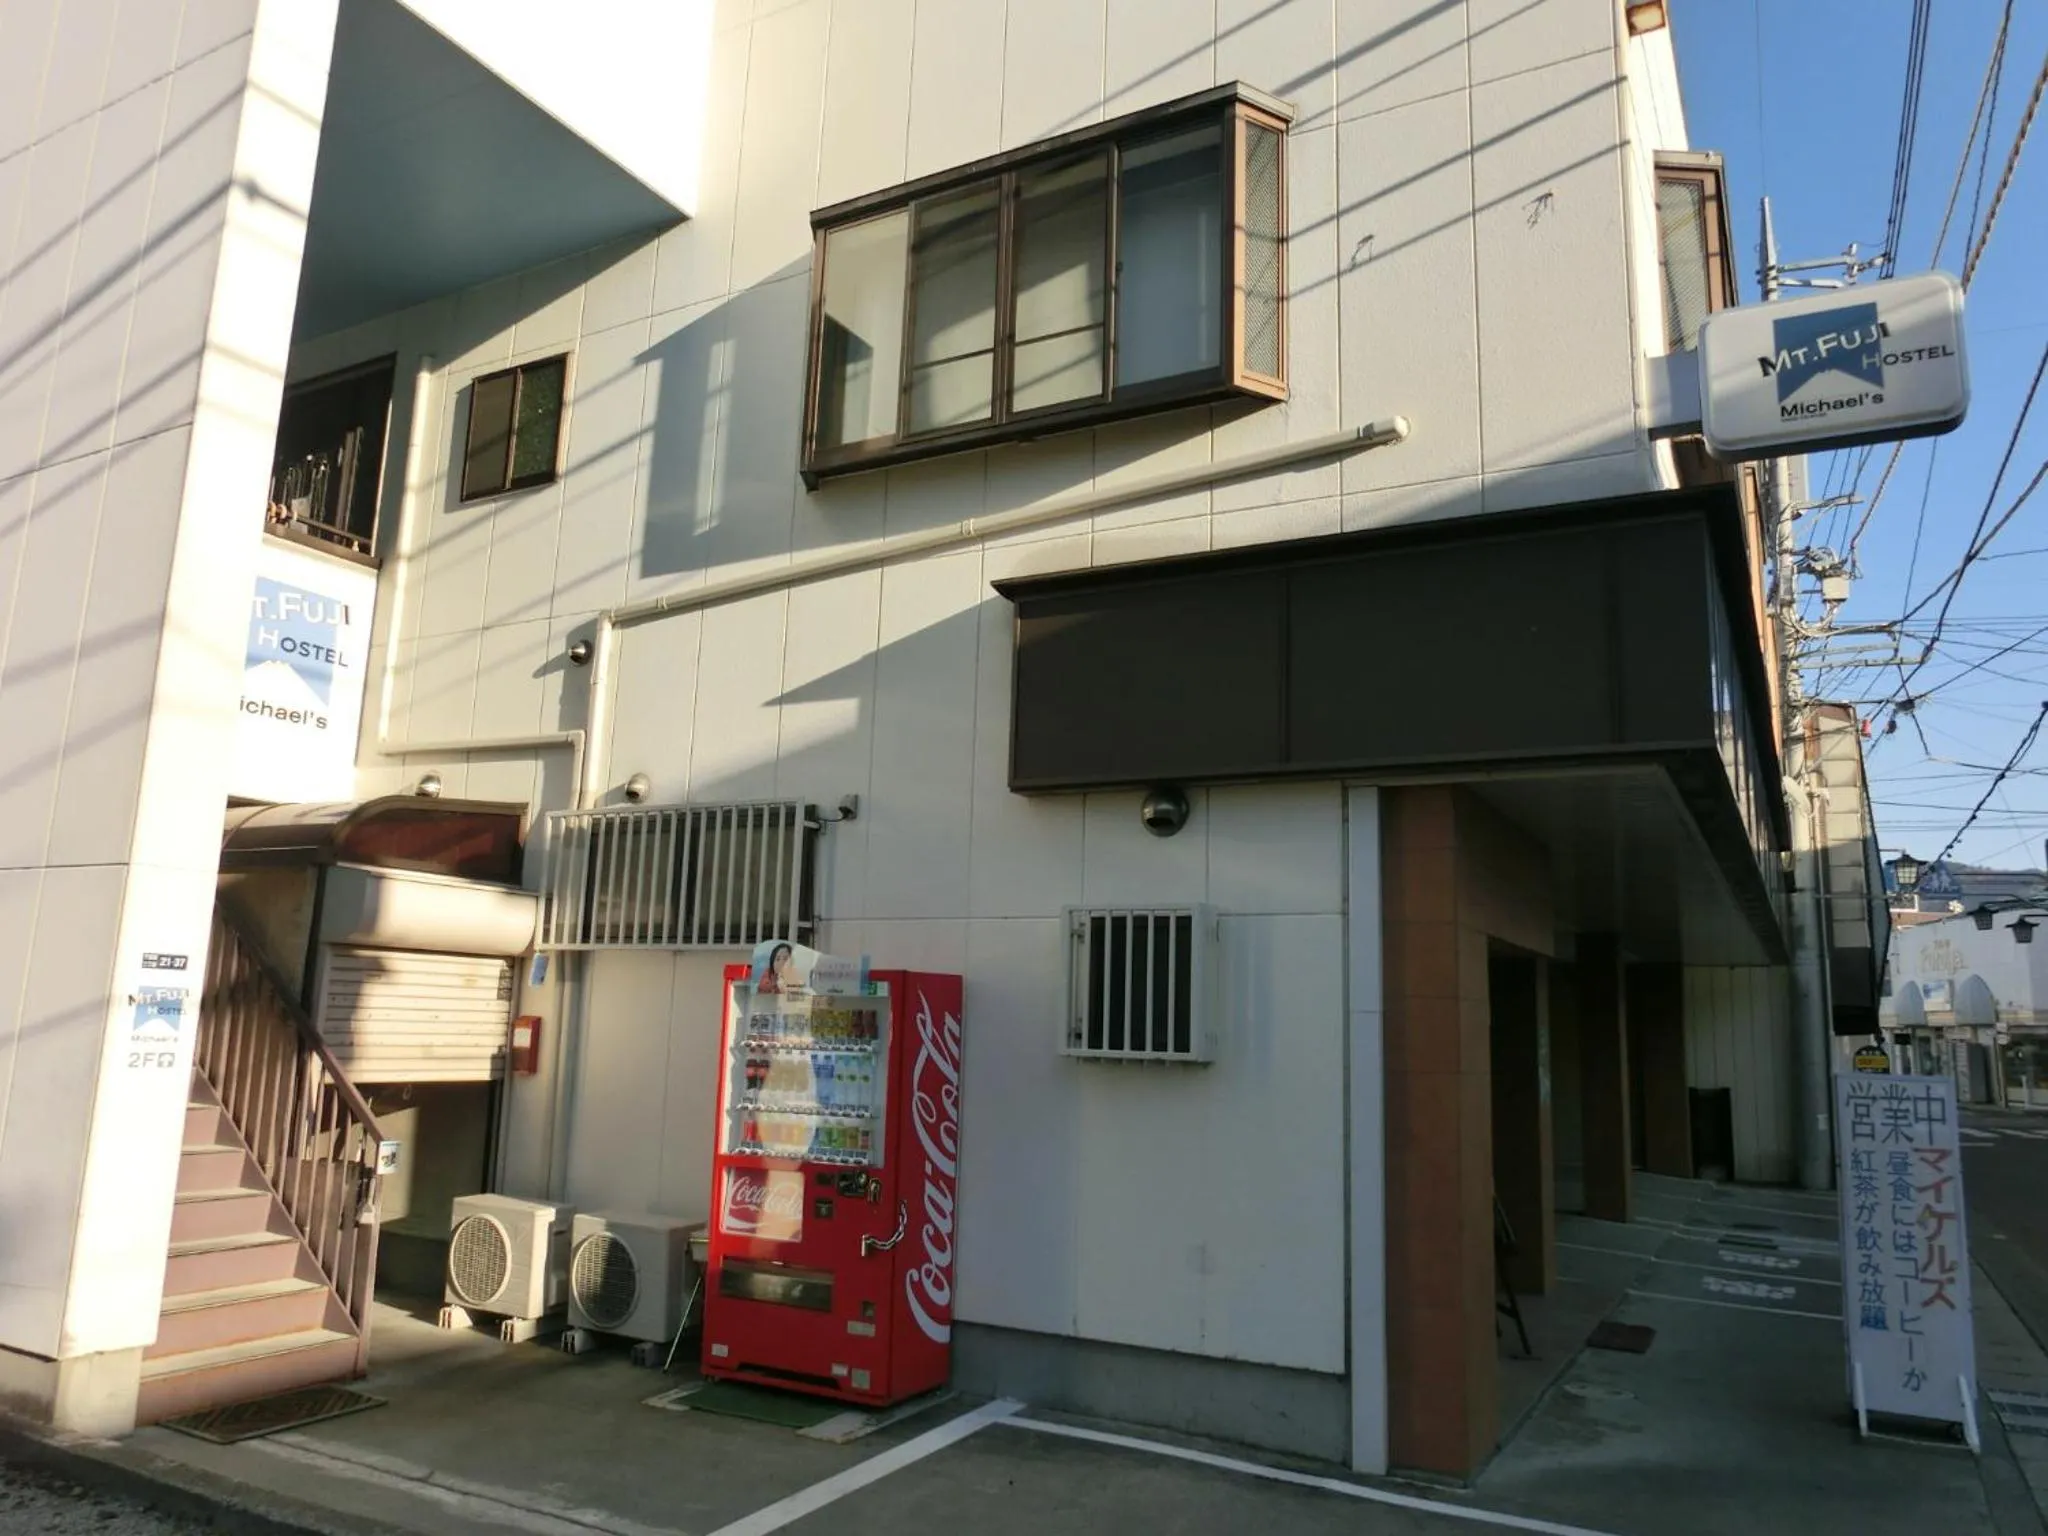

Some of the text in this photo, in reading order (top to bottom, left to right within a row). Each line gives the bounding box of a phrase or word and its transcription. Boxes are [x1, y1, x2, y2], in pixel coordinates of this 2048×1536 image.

[1861, 345, 1955, 371] HOSTEL
[1780, 391, 1885, 418] Michael's
[252, 592, 351, 626] T.FUJI
[257, 624, 349, 668] HOSTEL
[238, 695, 329, 730] ichael's
[1845, 1080, 1947, 1147] 営業中
[1850, 1147, 1890, 1332] 紅茶が飲み放題
[1911, 1146, 1960, 1311] マイケルズ
